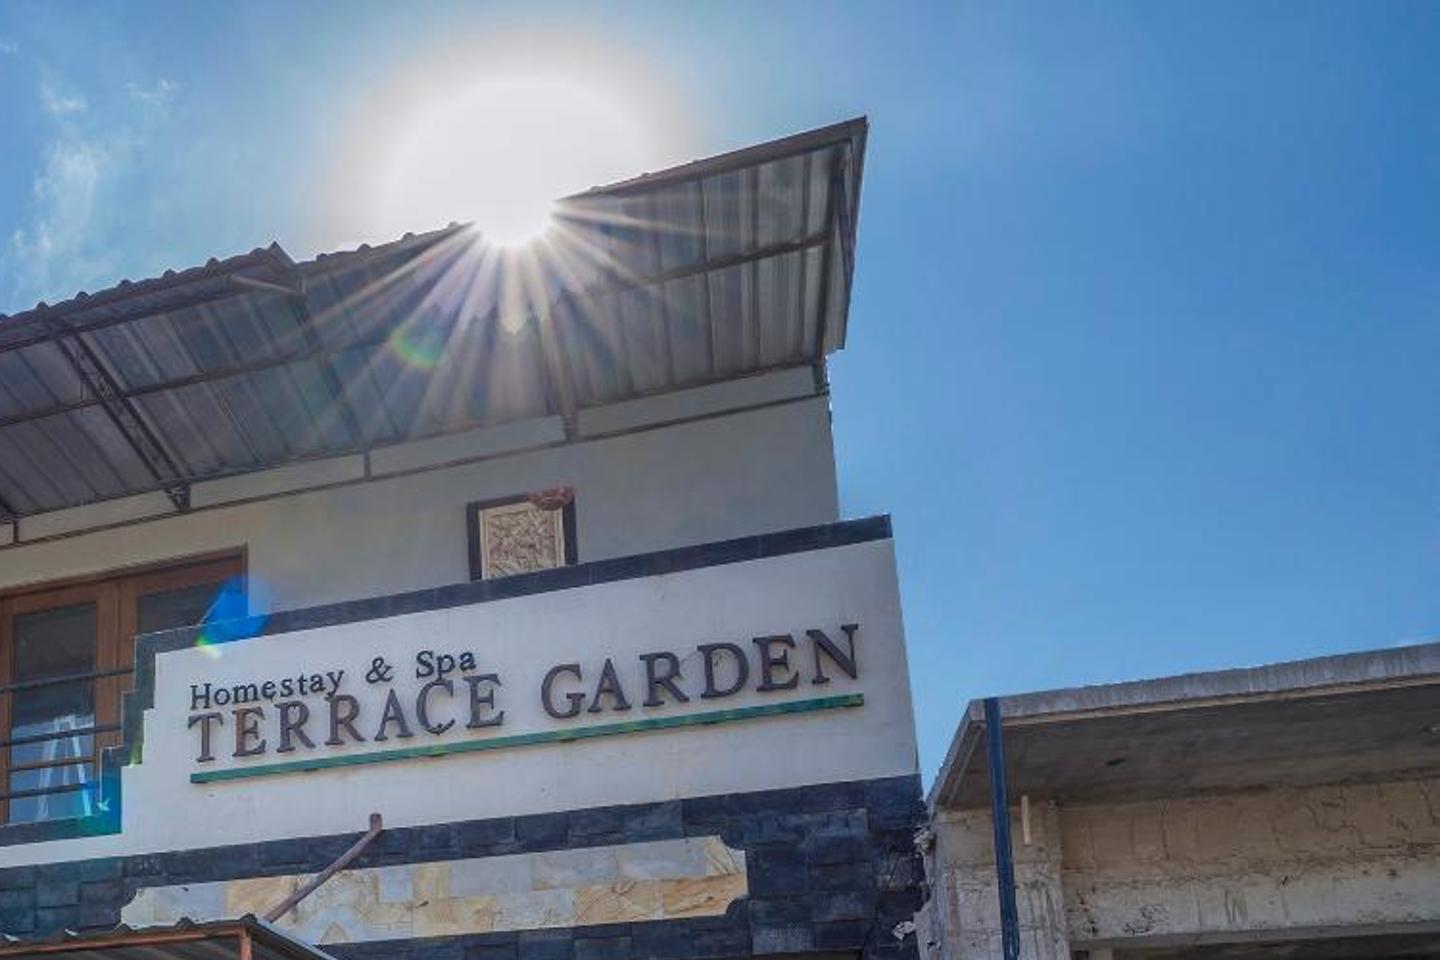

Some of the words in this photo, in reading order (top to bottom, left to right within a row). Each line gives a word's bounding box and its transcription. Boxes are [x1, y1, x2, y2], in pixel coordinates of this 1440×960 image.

[187, 672, 505, 763] TERRACE
[541, 623, 860, 719] GARDEN
[190, 670, 345, 711] Homestay
[365, 657, 393, 684] &
[416, 650, 476, 682] Spa
